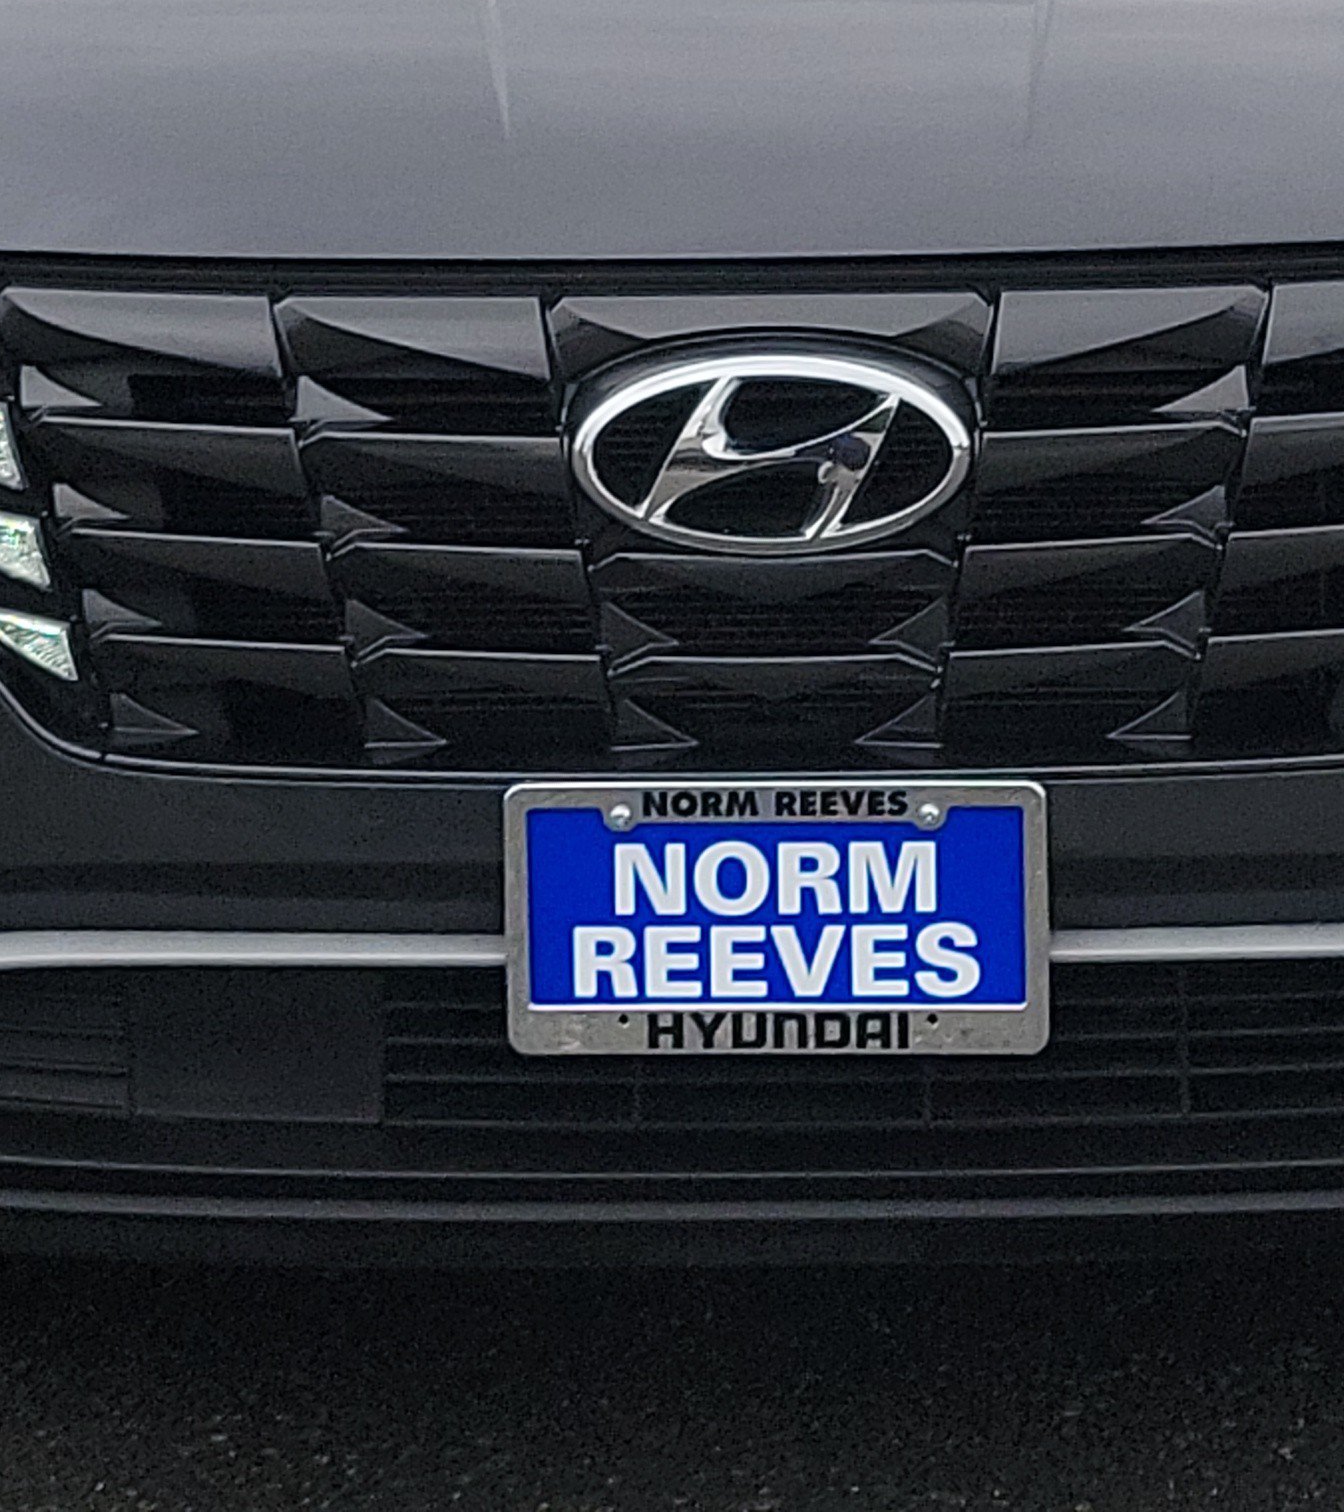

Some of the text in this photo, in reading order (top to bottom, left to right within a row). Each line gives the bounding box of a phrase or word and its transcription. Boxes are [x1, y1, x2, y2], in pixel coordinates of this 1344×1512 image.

[642, 789, 909, 818] NORM REEVES
[613, 840, 938, 916] NORM
[572, 921, 982, 999] REEVES
[647, 1011, 910, 1050] HYUNDAI
